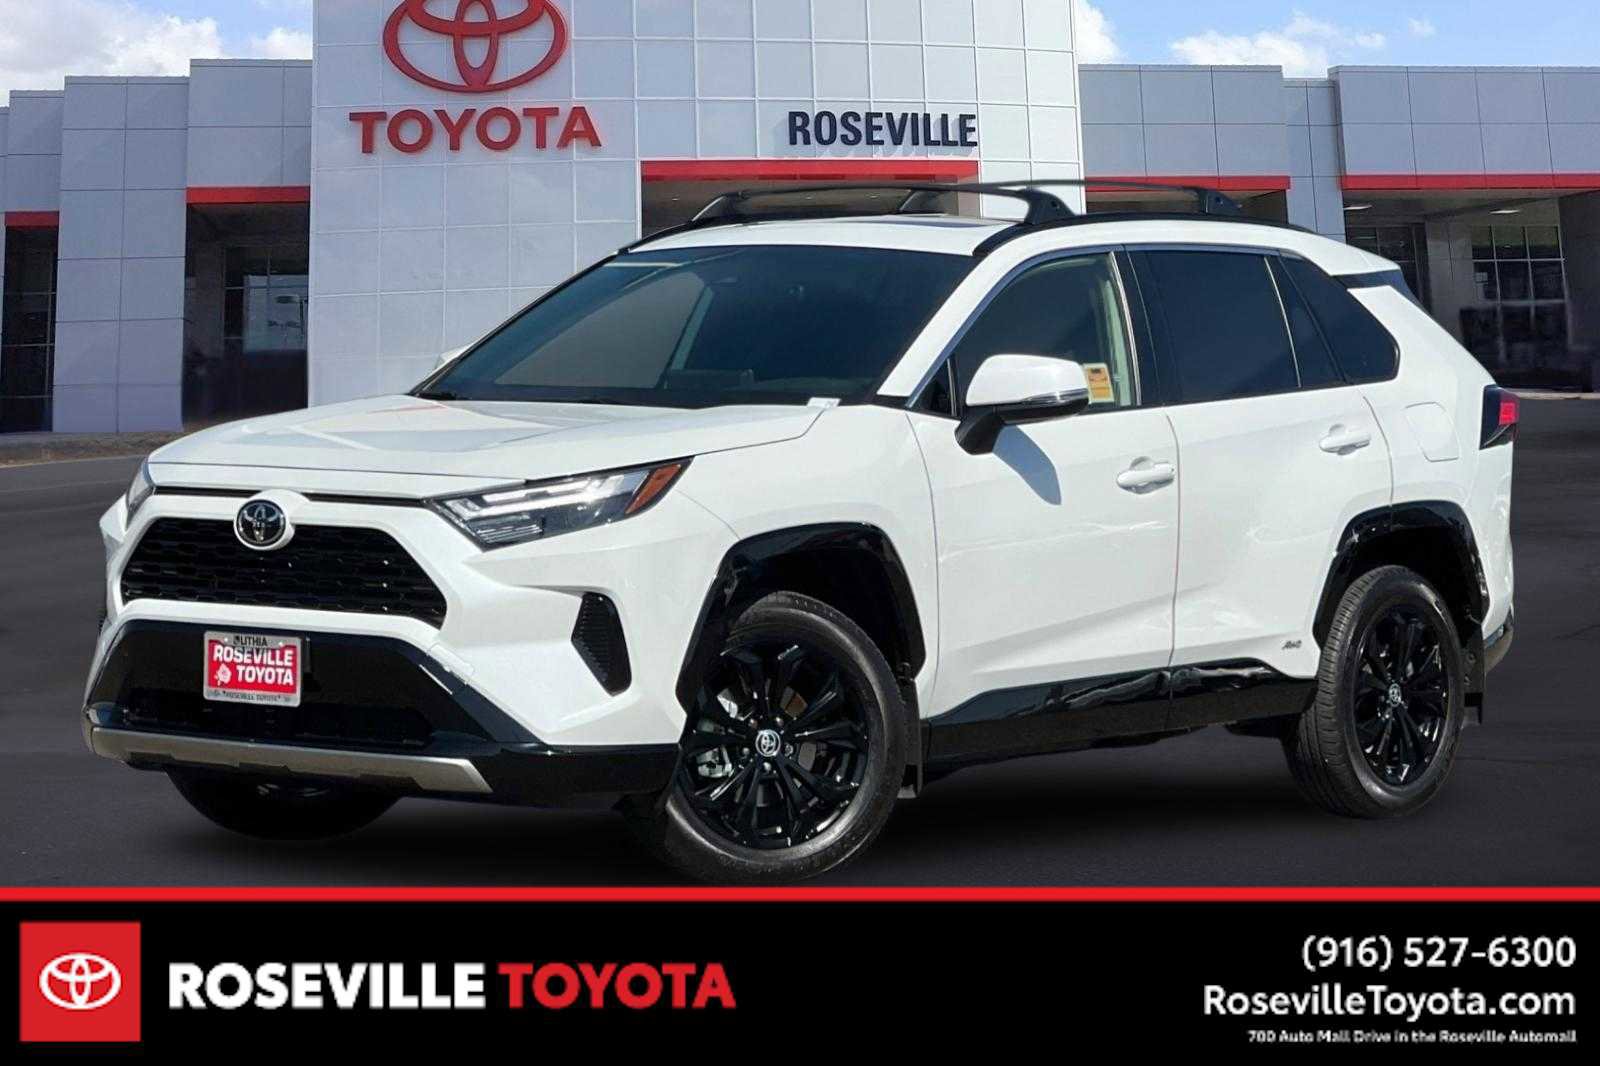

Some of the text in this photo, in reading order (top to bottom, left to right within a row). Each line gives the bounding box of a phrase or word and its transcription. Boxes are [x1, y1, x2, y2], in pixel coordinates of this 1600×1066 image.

[349, 106, 602, 153] TOYOTA
[789, 111, 977, 146] ROSEVILLE
[240, 635, 267, 646] LITHIA
[213, 644, 294, 667] ROSEVILLE
[236, 664, 294, 686] TOYOTA
